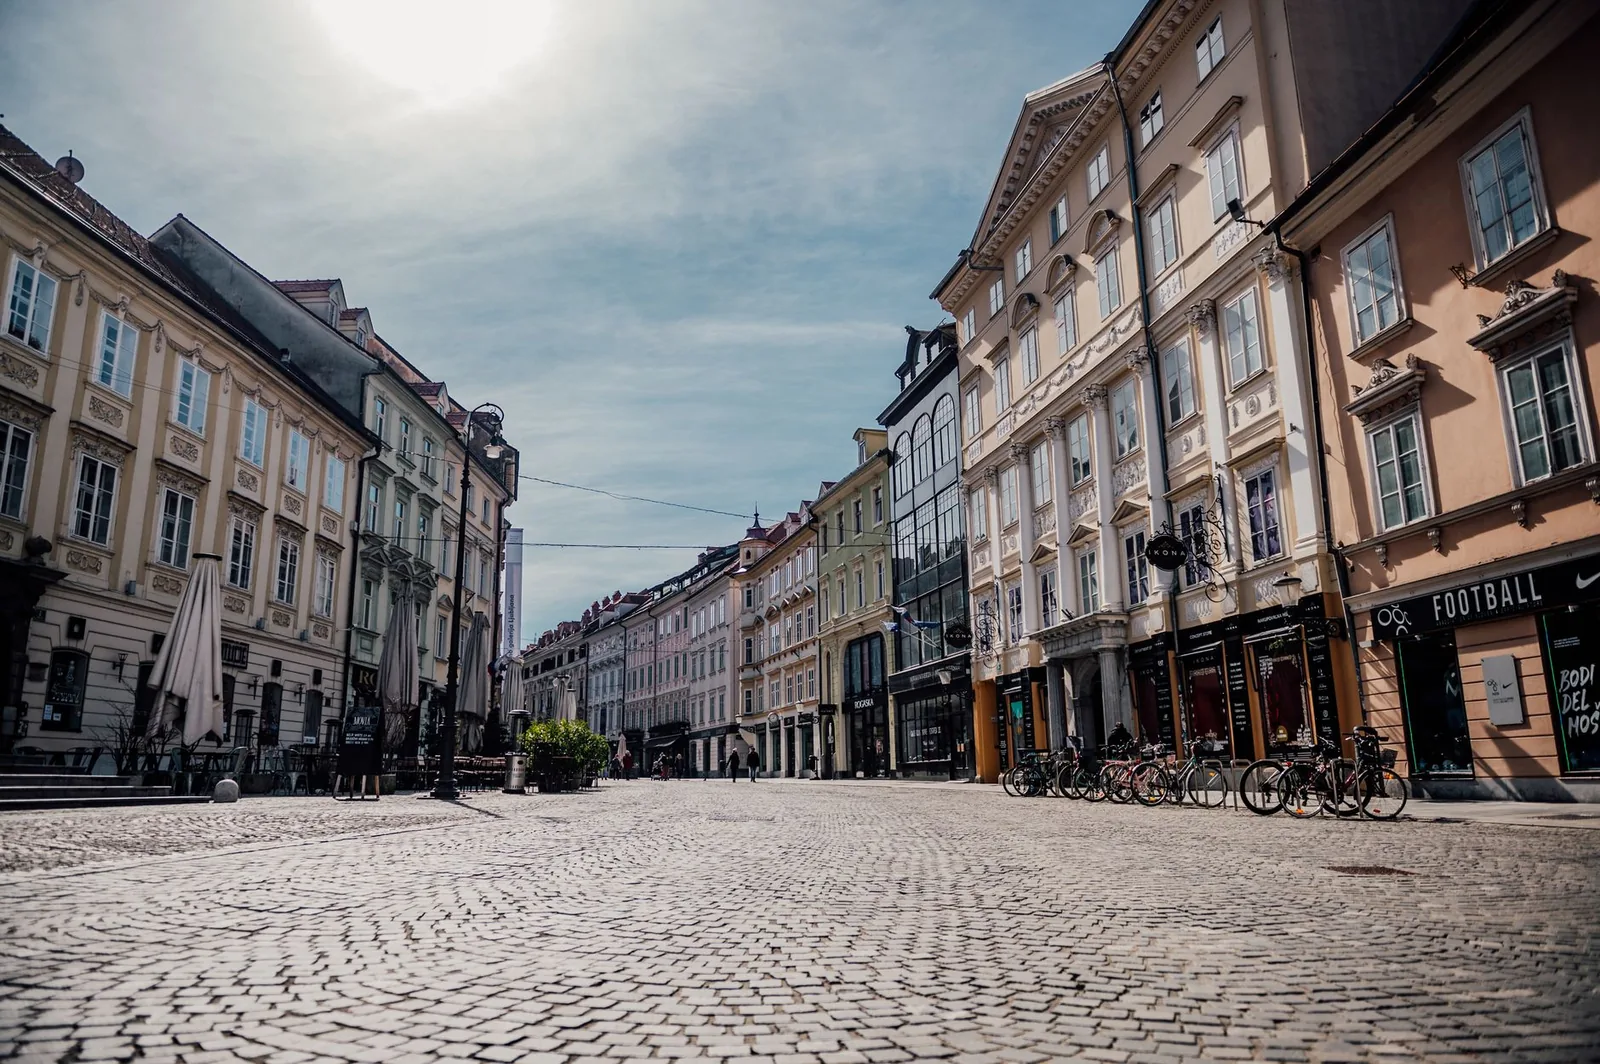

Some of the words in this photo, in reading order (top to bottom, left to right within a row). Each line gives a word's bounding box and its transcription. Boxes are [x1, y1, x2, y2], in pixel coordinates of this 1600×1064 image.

[507, 594, 516, 623] Ljubljana
[1432, 572, 1543, 621] FOOTBALL
[1558, 663, 1596, 693] BODI
[1561, 688, 1591, 715] DEL
